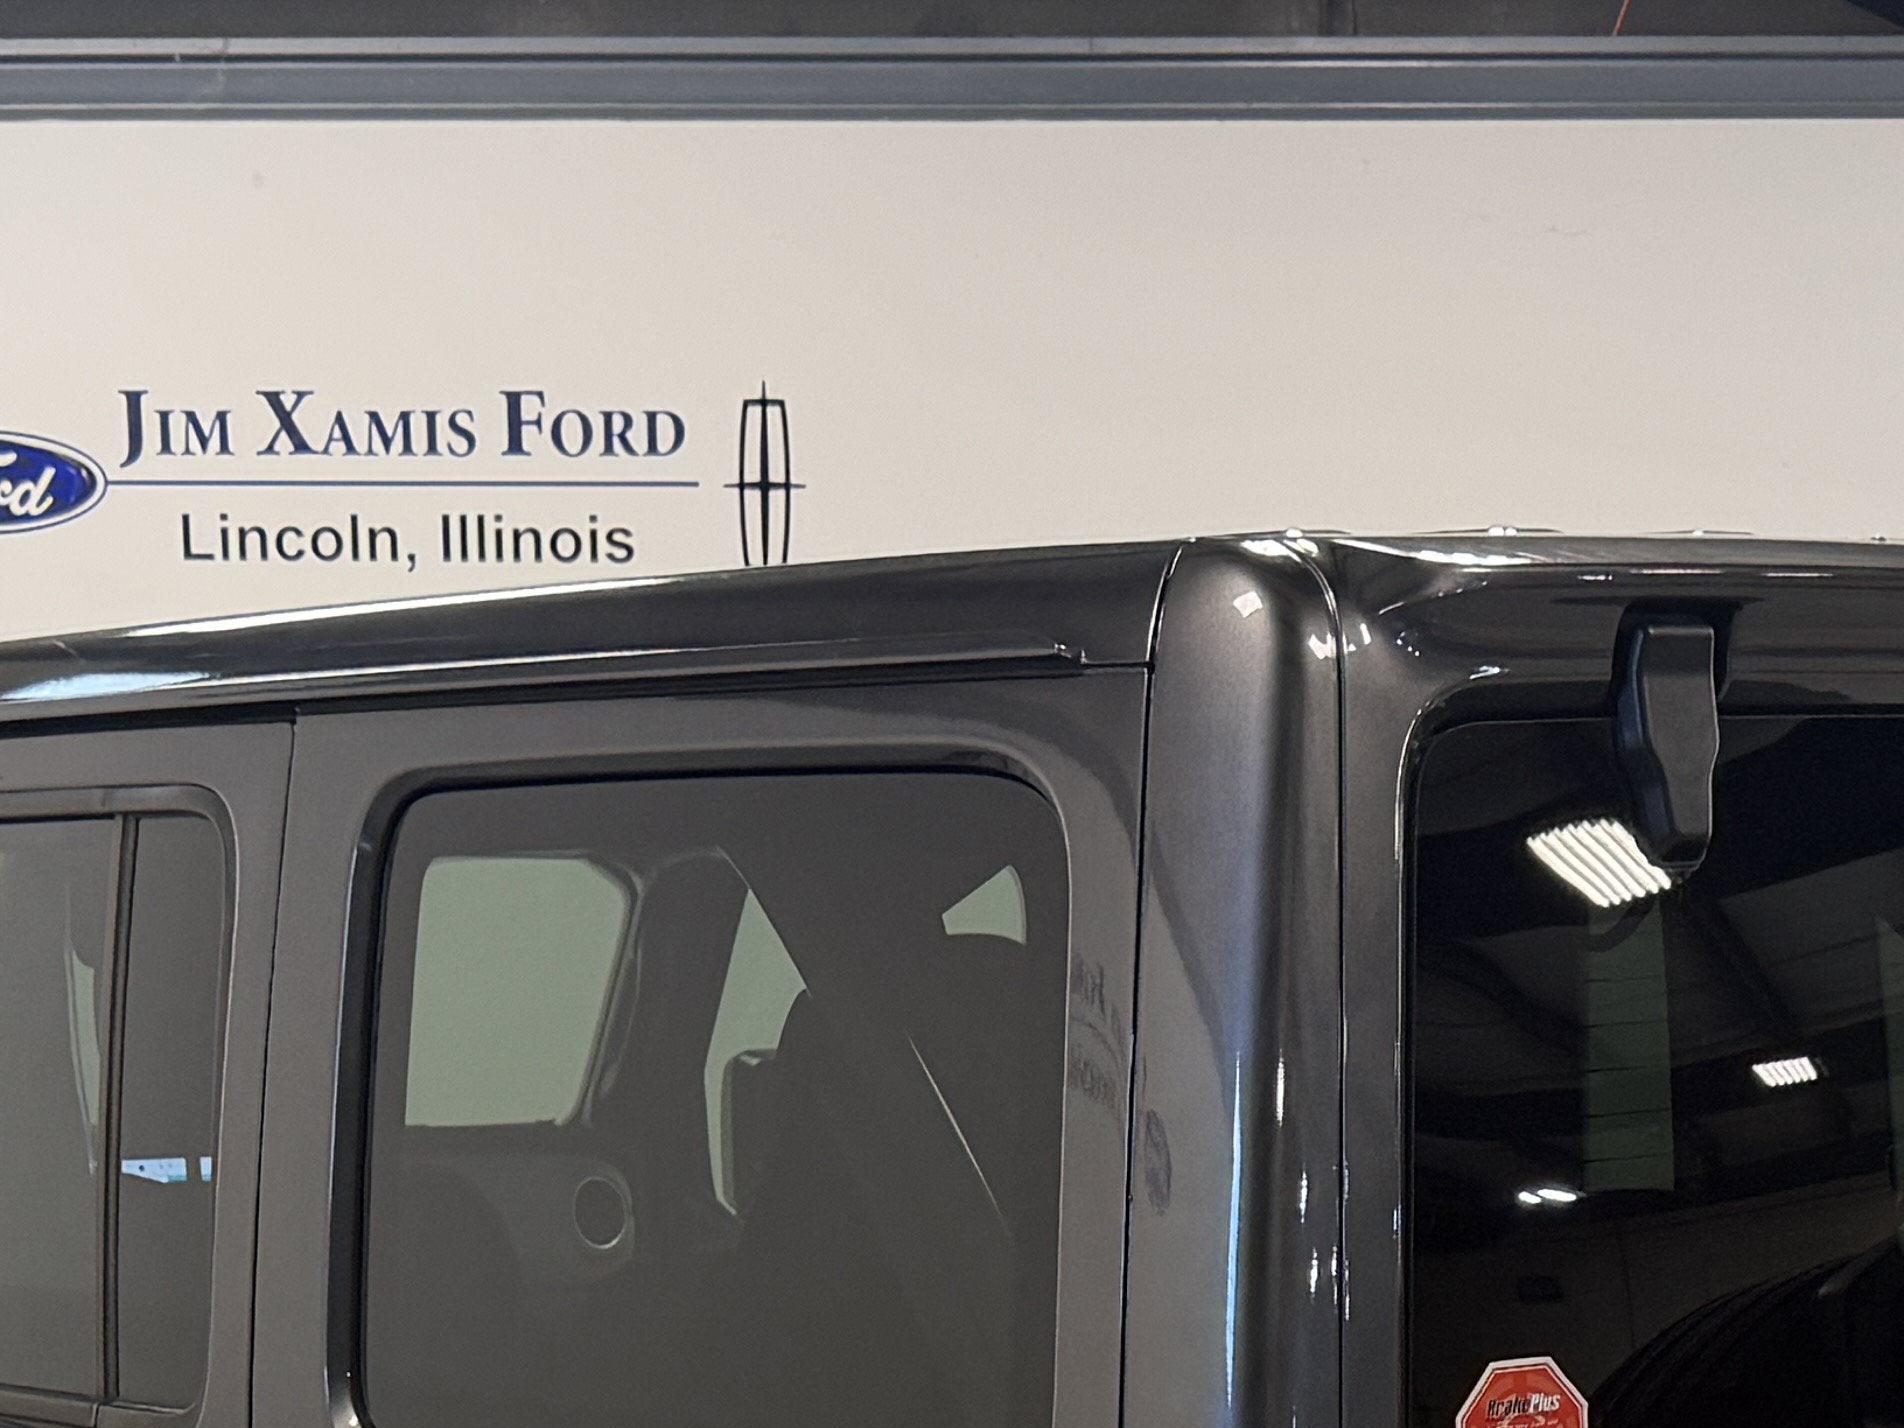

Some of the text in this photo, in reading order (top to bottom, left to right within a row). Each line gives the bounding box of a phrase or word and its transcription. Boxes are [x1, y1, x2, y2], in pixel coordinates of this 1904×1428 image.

[118, 390, 685, 468] JIM XAMIS FORD
[182, 513, 634, 572] Lincoln, Illinois
